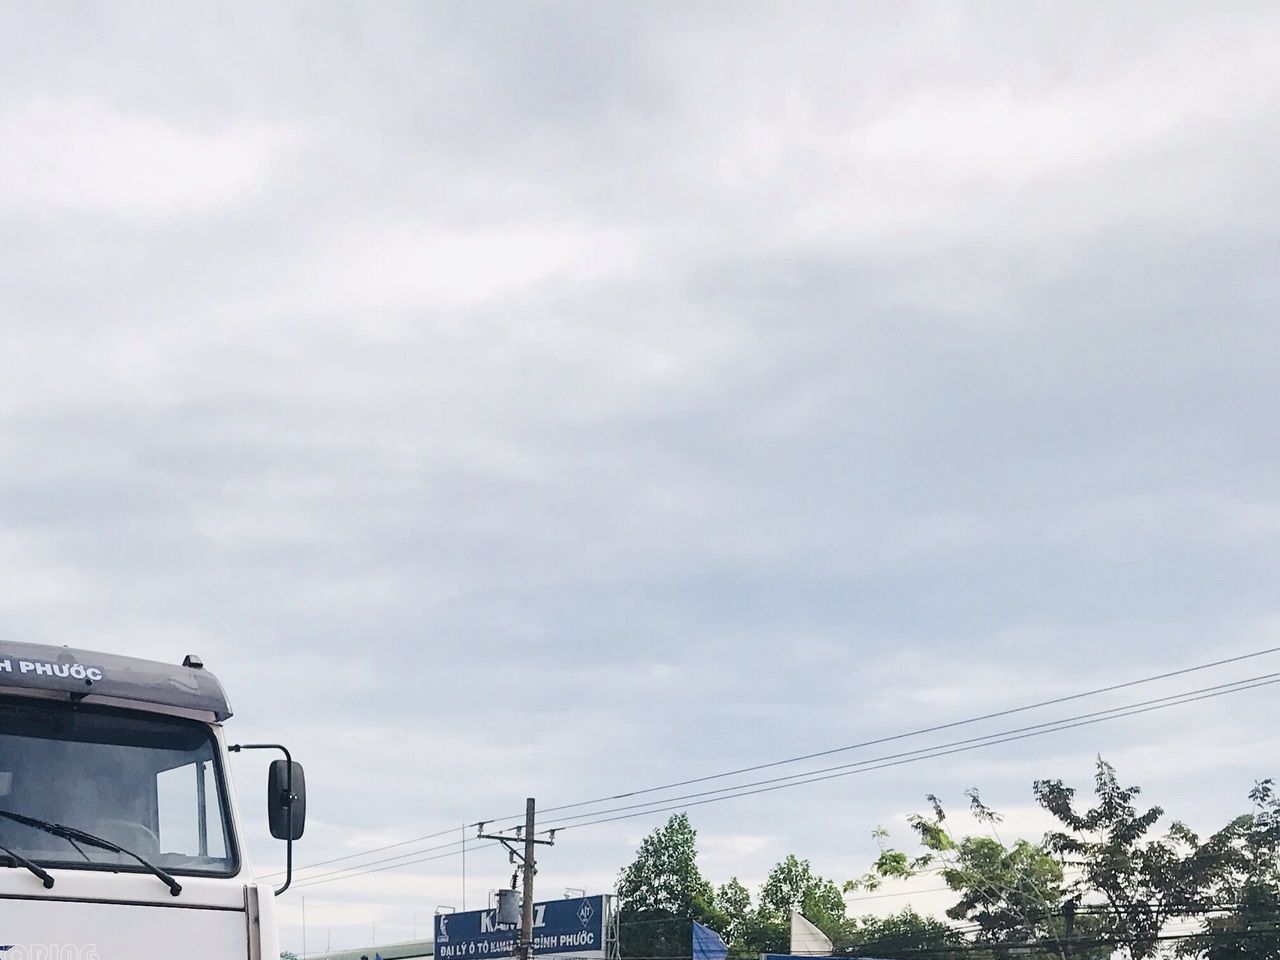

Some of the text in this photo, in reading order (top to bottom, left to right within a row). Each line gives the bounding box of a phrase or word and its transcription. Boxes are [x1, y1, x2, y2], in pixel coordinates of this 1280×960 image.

[19, 662, 103, 681] PHƯỚC
[559, 929, 594, 946] PHƯỚC
[456, 941, 467, 956] LÝ
[477, 941, 489, 954] TÔ
